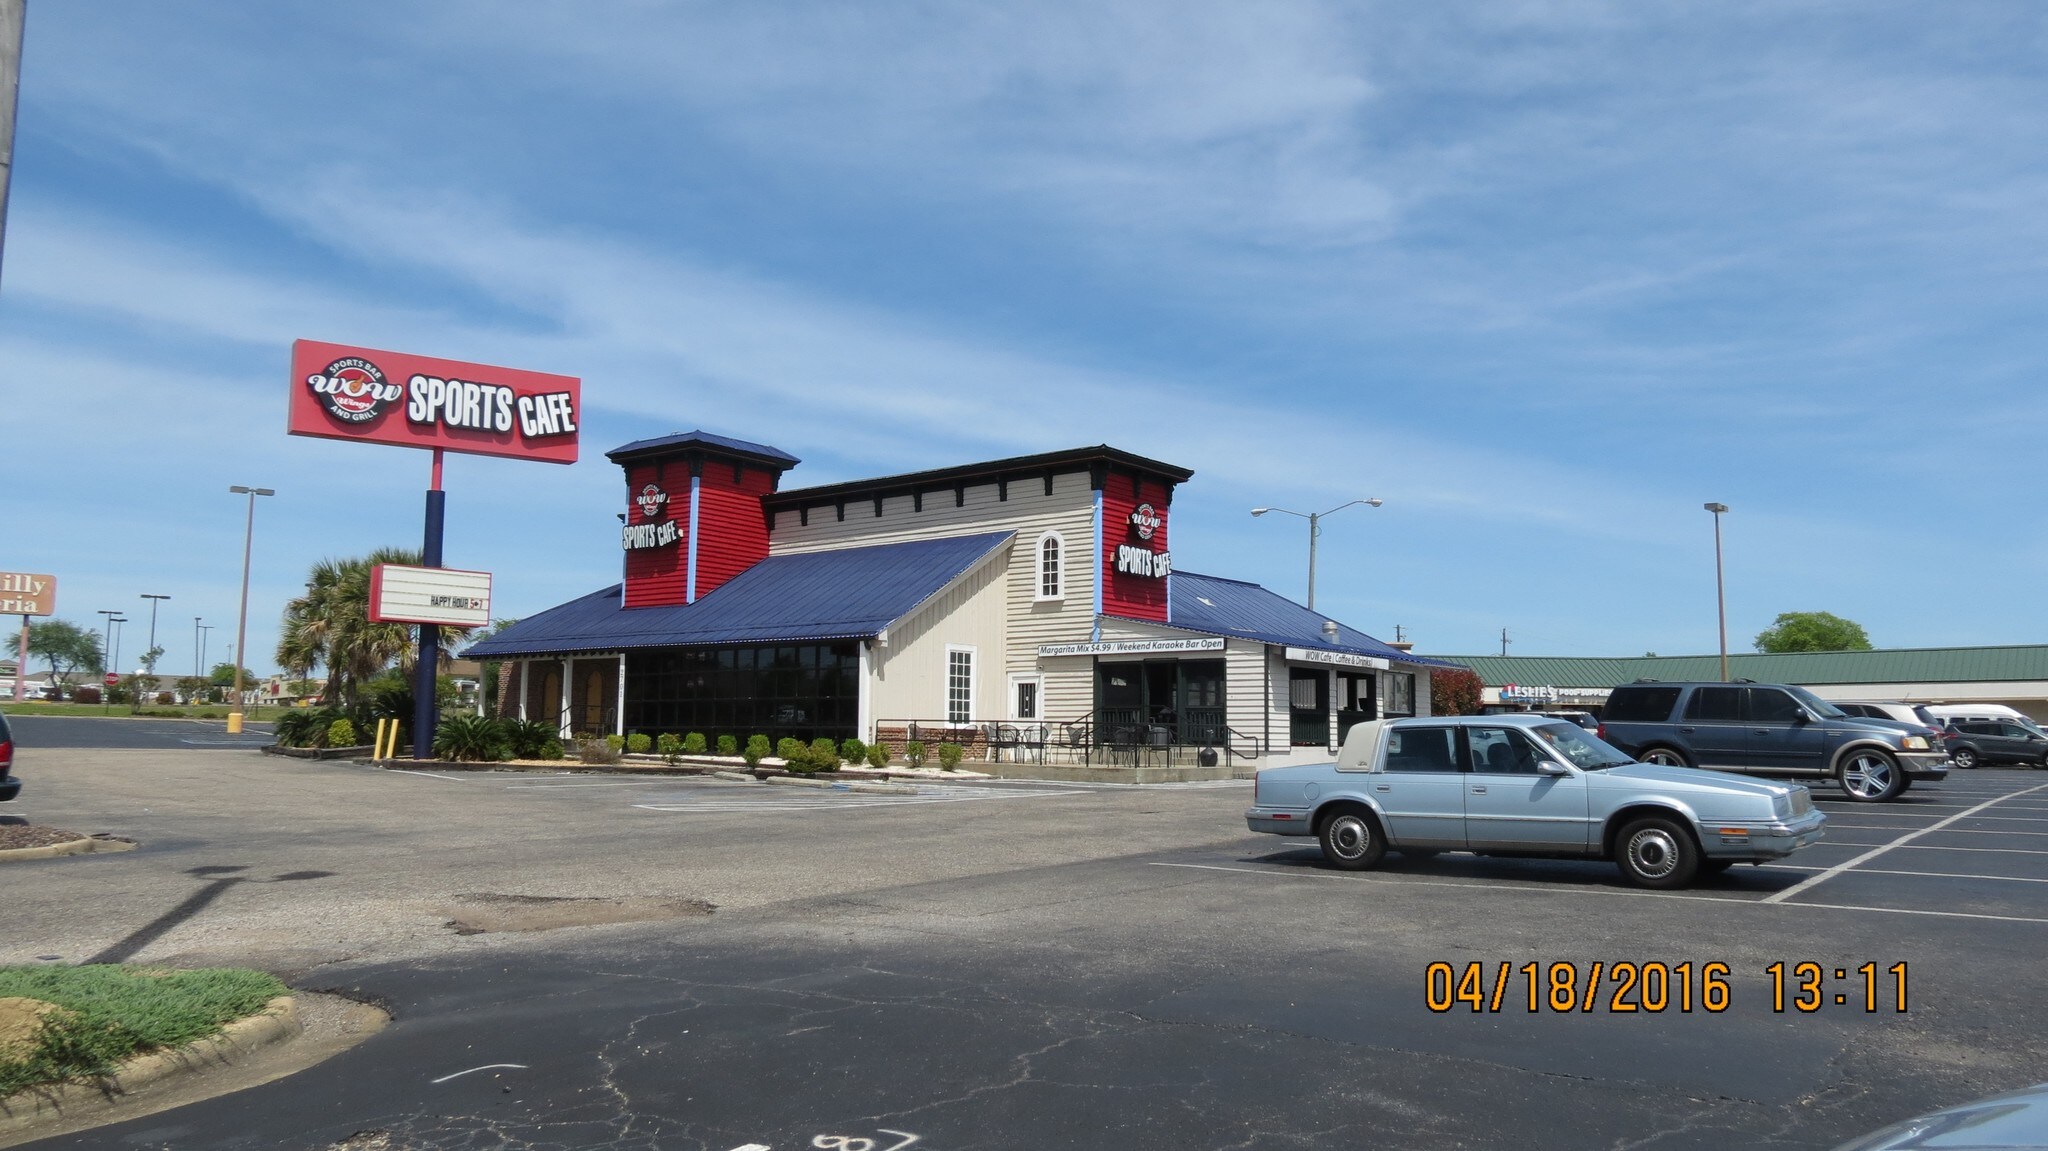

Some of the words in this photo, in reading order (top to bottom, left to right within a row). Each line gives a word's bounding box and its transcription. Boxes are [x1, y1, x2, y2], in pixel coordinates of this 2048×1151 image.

[329, 359, 364, 374] SPORTS
[364, 363, 382, 379] BAR
[330, 405, 351, 420] AND
[352, 411, 378, 421] GRILL
[408, 375, 514, 432] SPORTS
[518, 393, 576, 437] CAFE
[623, 524, 655, 550] SPORTS
[657, 520, 677, 546] CAFE
[1119, 544, 1152, 576] SPORTS
[1153, 552, 1172, 578] CAFE
[0, 574, 46, 596] illy
[0, 595, 38, 613] ria
[431, 595, 451, 607] HAPPY
[452, 597, 468, 609] HOUR
[1040, 645, 1075, 656] Margarita
[1076, 643, 1089, 653] Mix
[1091, 643, 1111, 653] $4.99
[1116, 641, 1151, 651] Weekend
[1152, 640, 1184, 650] Karaoke
[1185, 640, 1200, 649] Bar
[1201, 639, 1222, 650] Open
[1305, 650, 1320, 661] WOW
[1335, 654, 1351, 665] Coffee
[1508, 684, 1554, 698] LESLIE'S
